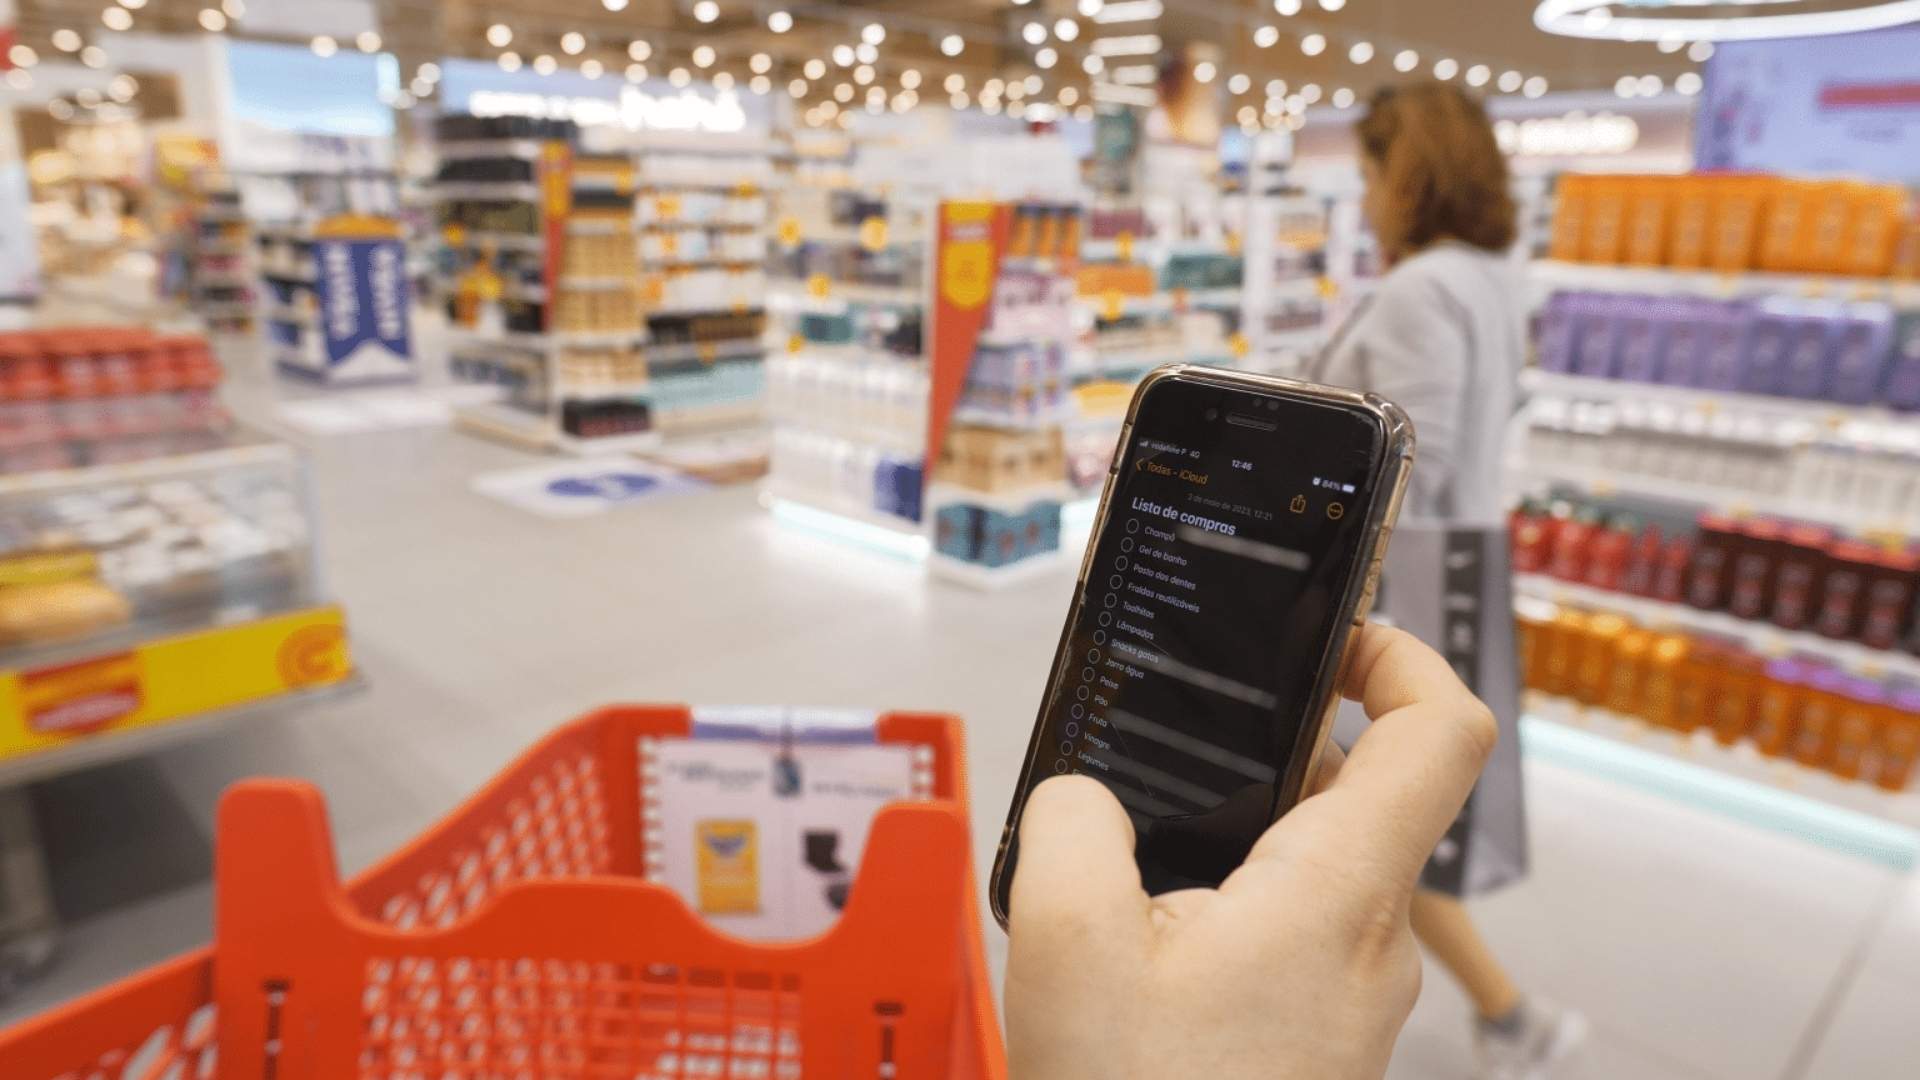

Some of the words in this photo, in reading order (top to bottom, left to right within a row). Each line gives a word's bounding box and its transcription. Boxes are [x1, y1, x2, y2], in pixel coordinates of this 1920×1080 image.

[1146, 461, 1171, 478] Todas
[1179, 468, 1208, 486] iCloud
[1231, 460, 1253, 471] 12:46
[1131, 496, 1160, 515] Lista
[1162, 505, 1178, 520] de
[1180, 512, 1236, 535] compras
[1139, 544, 1152, 555] Gel
[1152, 549, 1162, 559] de
[1163, 551, 1187, 567] banho
[1128, 582, 1155, 598] Fraldas
[1170, 576, 1196, 590] dentes
